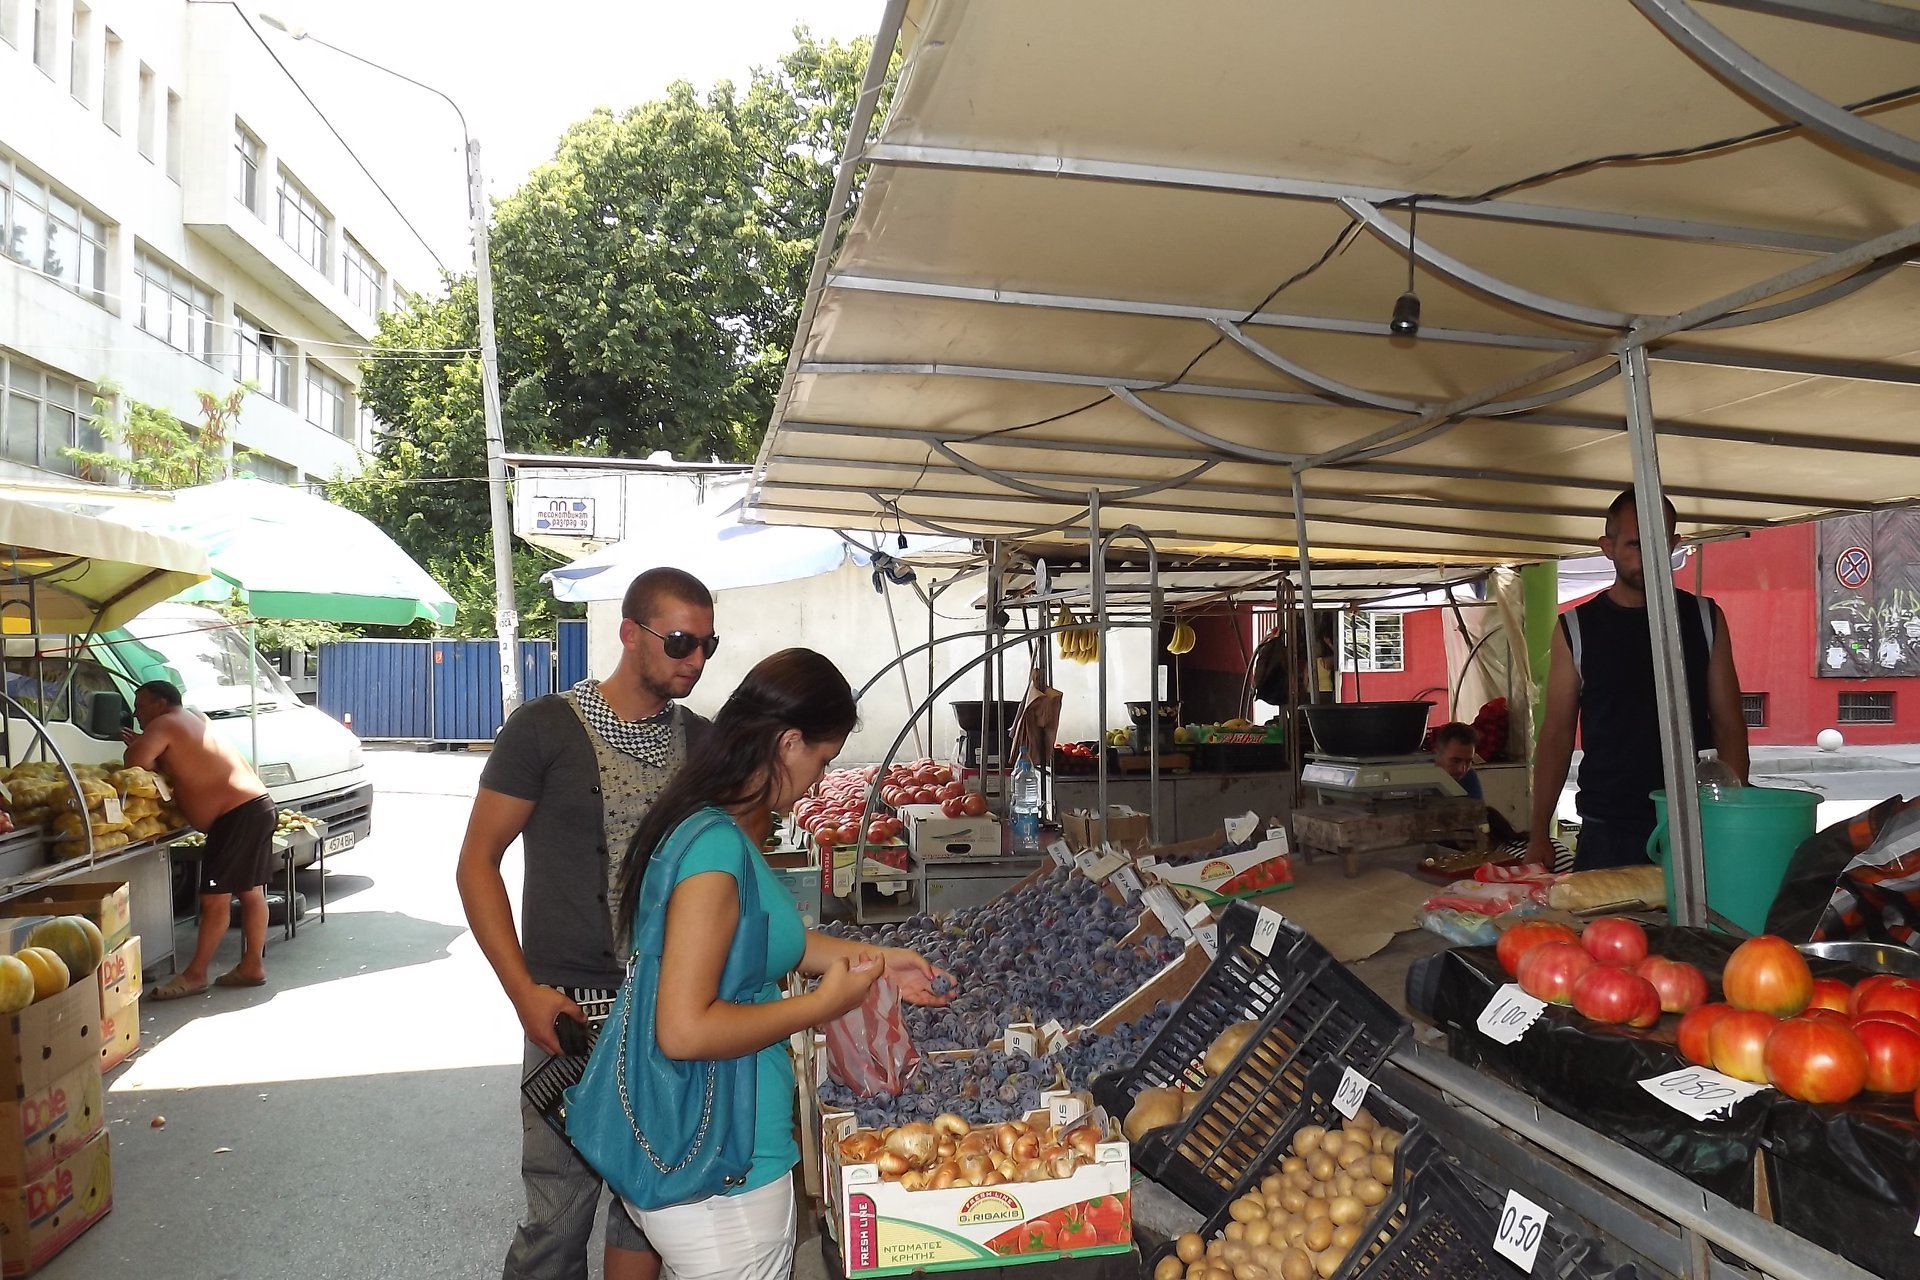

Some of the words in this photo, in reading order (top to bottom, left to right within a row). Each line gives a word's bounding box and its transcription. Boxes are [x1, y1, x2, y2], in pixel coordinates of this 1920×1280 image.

[103, 954, 125, 983] Dole
[22, 1086, 66, 1138] Dole
[26, 1168, 73, 1221] Dole
[859, 1202, 868, 1228] LINE
[860, 1231, 870, 1267] FRESH
[884, 1241, 942, 1253] ΝΤΟΜΑΤΕΣ
[892, 1251, 936, 1263] ΚΡΗΤΗΣ
